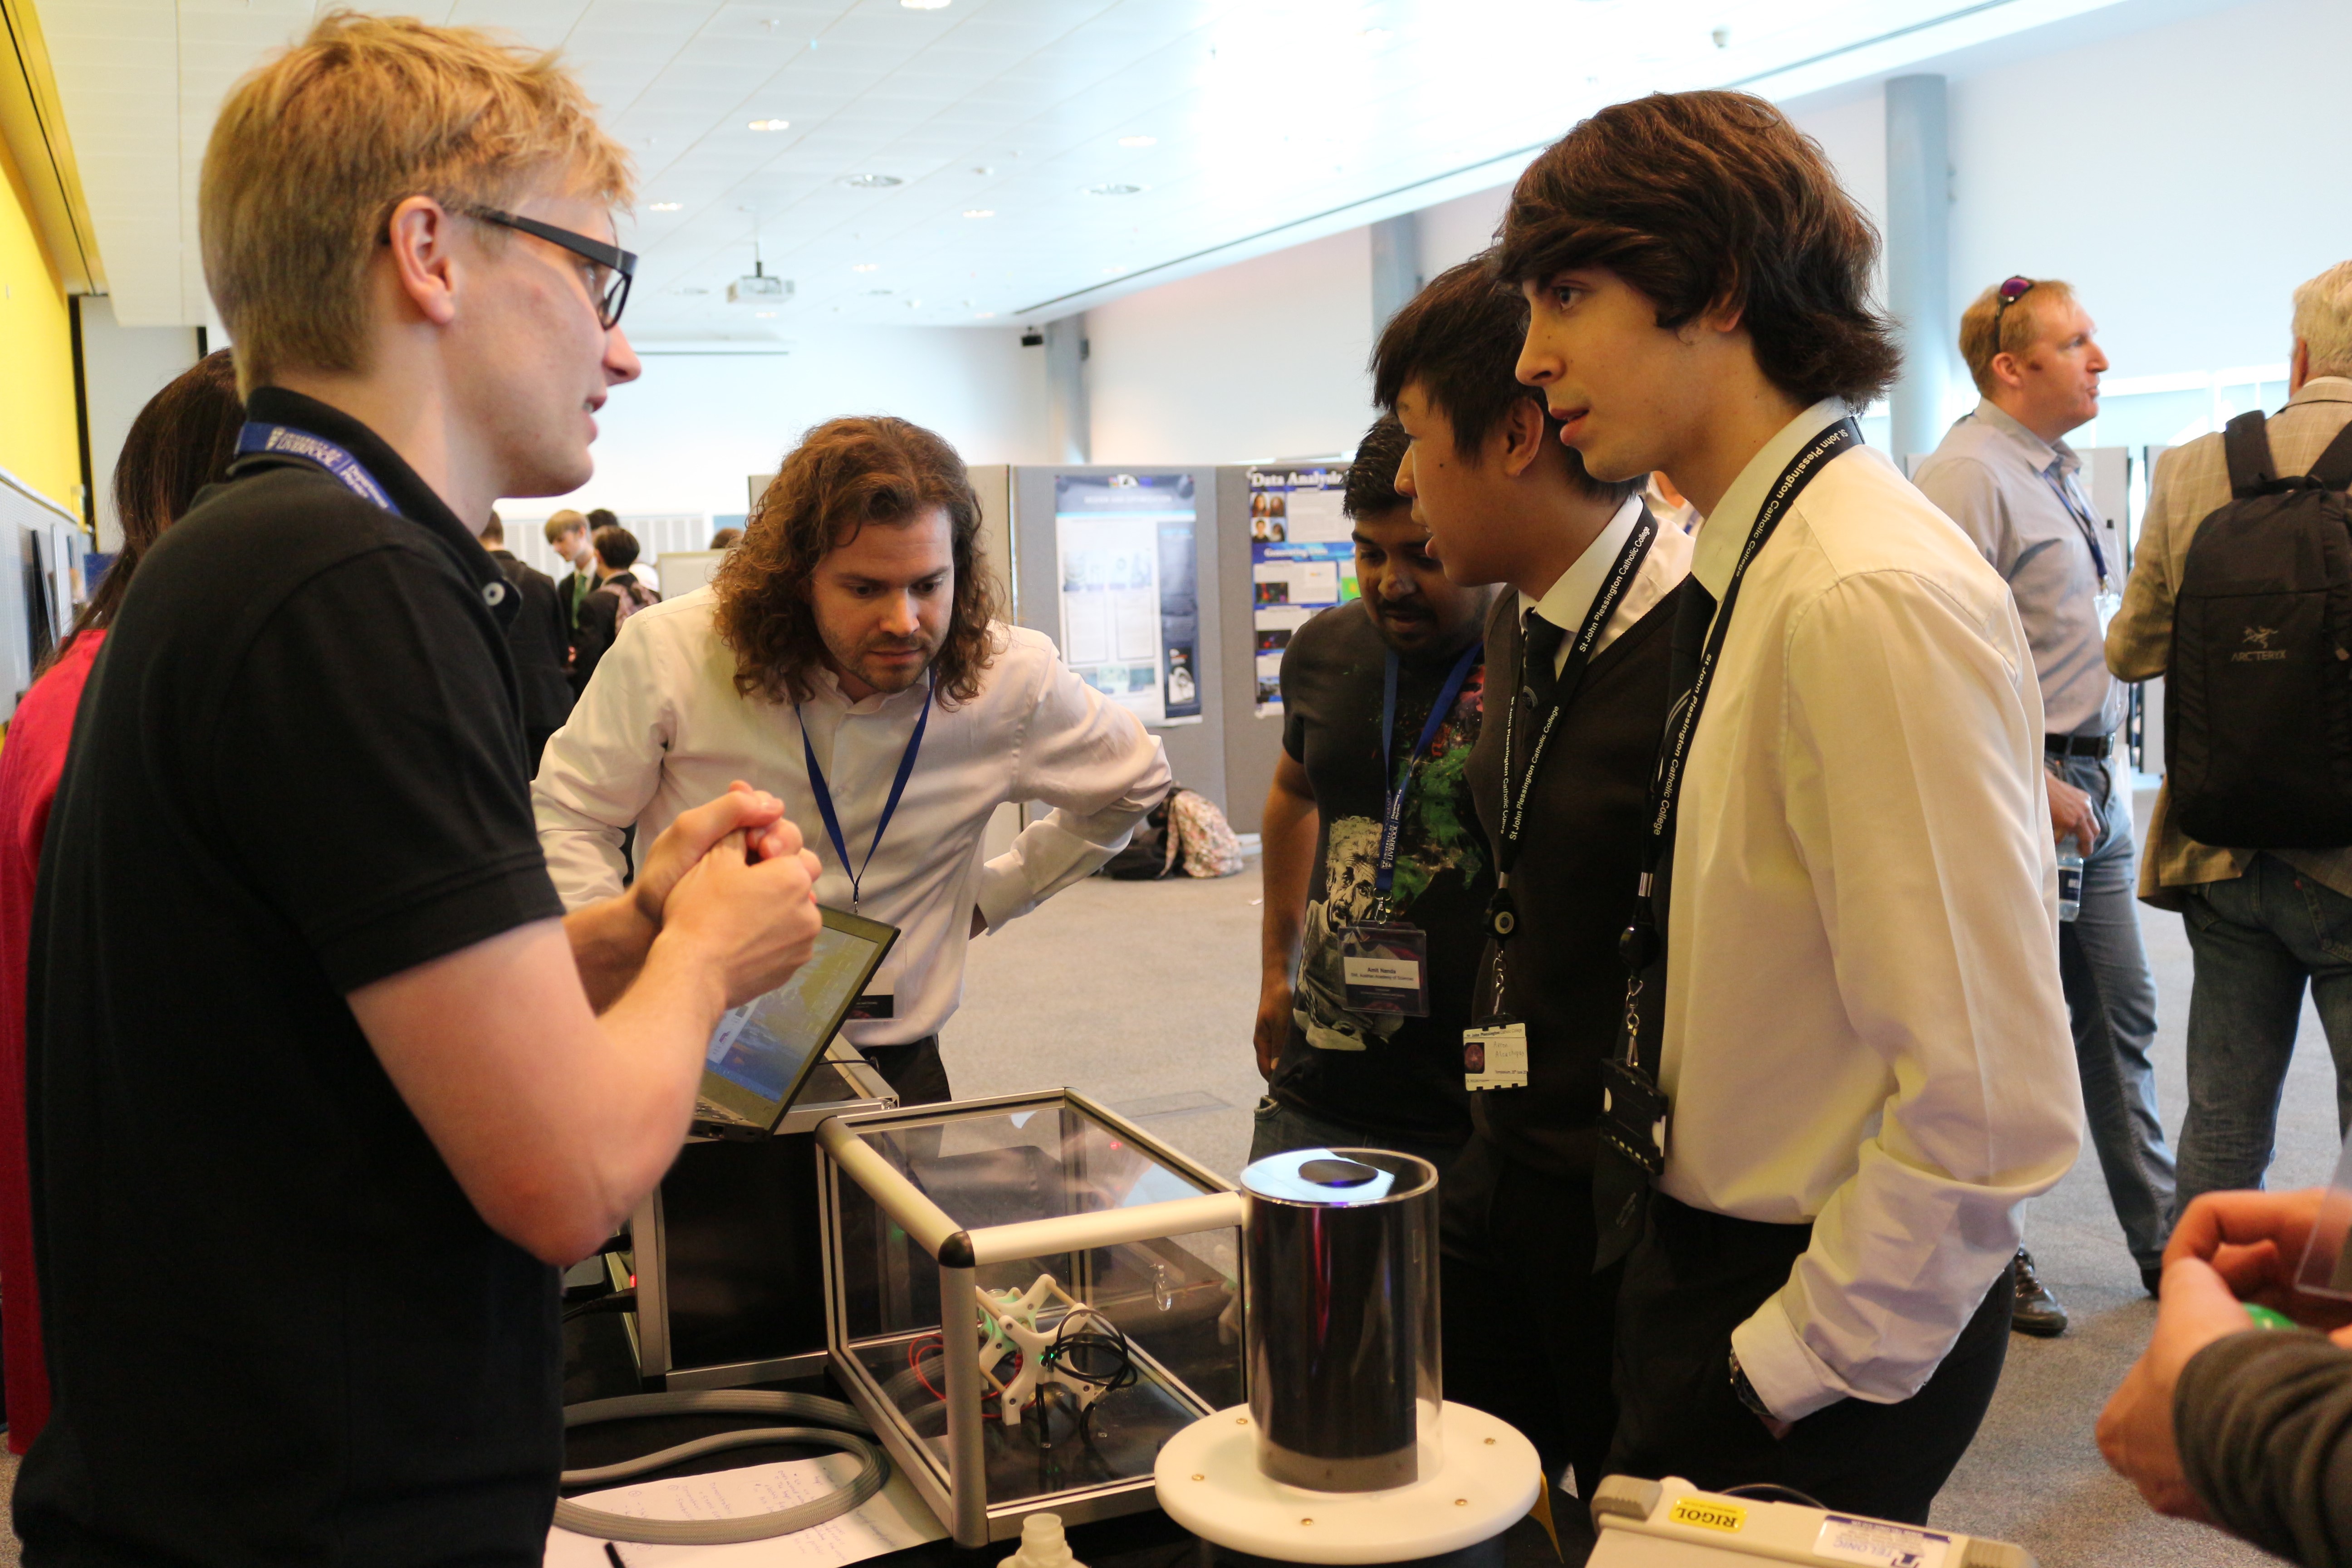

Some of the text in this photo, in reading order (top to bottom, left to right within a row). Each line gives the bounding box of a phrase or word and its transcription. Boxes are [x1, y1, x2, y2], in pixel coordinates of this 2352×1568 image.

[1252, 473, 1284, 487] Data
[1736, 429, 1848, 577] St John Plessington Catholic College
[1579, 526, 1651, 652] St John Plessington Catholic College
[1509, 706, 1559, 840] St John Plessington Catholic College
[1654, 653, 1712, 836] St John Plessington Catholic College
[1387, 825, 1398, 860] LIVERPOOL
[1391, 795, 1400, 819] Department
[1676, 1507, 1739, 1528] RIGOL
